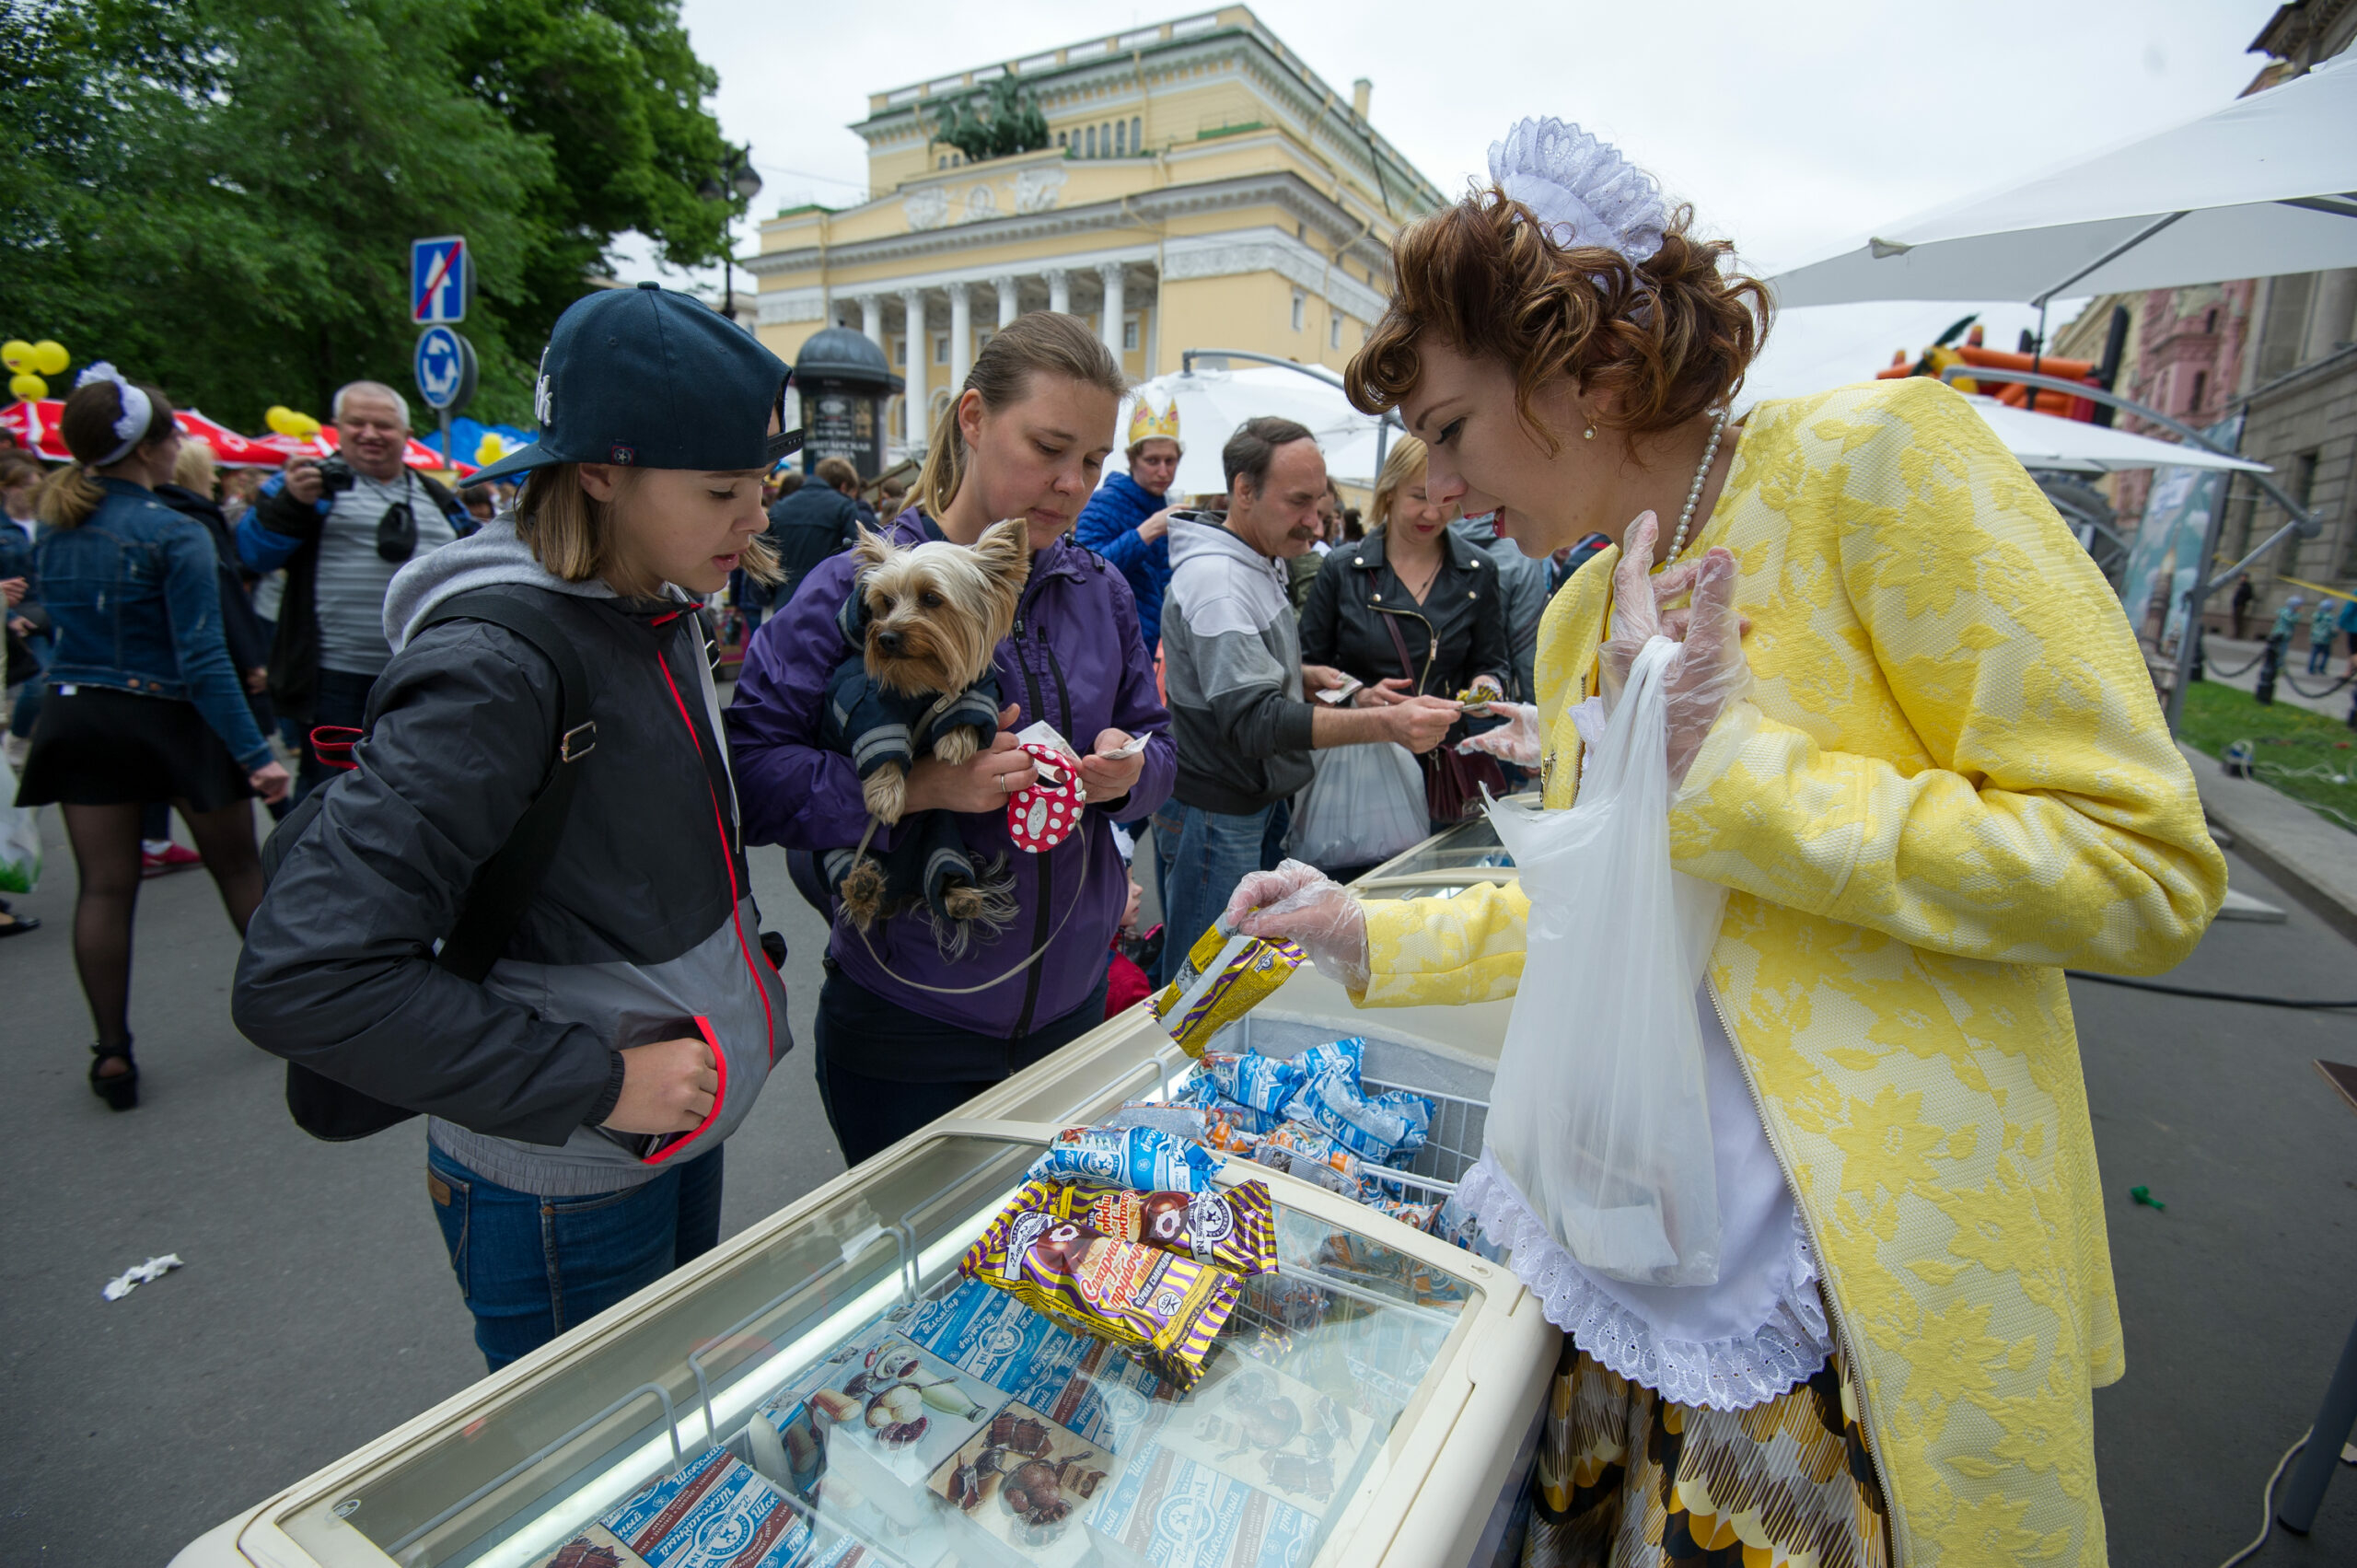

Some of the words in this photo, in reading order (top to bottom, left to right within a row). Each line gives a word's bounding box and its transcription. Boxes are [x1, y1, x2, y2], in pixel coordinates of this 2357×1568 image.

[1095, 1195, 1115, 1234] труб
[1135, 1246, 1161, 1281] ПЛОМБИ
[1196, 1239, 1209, 1257] №1
[1081, 1237, 1123, 1302] Сахарная
[1134, 1283, 1153, 1307] ЧЕРНАЯ
[1147, 1249, 1173, 1285] СМОРОДИН
[921, 1296, 960, 1335] Пломбир
[956, 1309, 995, 1350] Пломбир
[1030, 1336, 1064, 1376] Пломбир
[657, 1486, 735, 1556] Шоколадный
[699, 1494, 751, 1553] Хладокомбинат
[1197, 1491, 1240, 1568] Шоколадный
